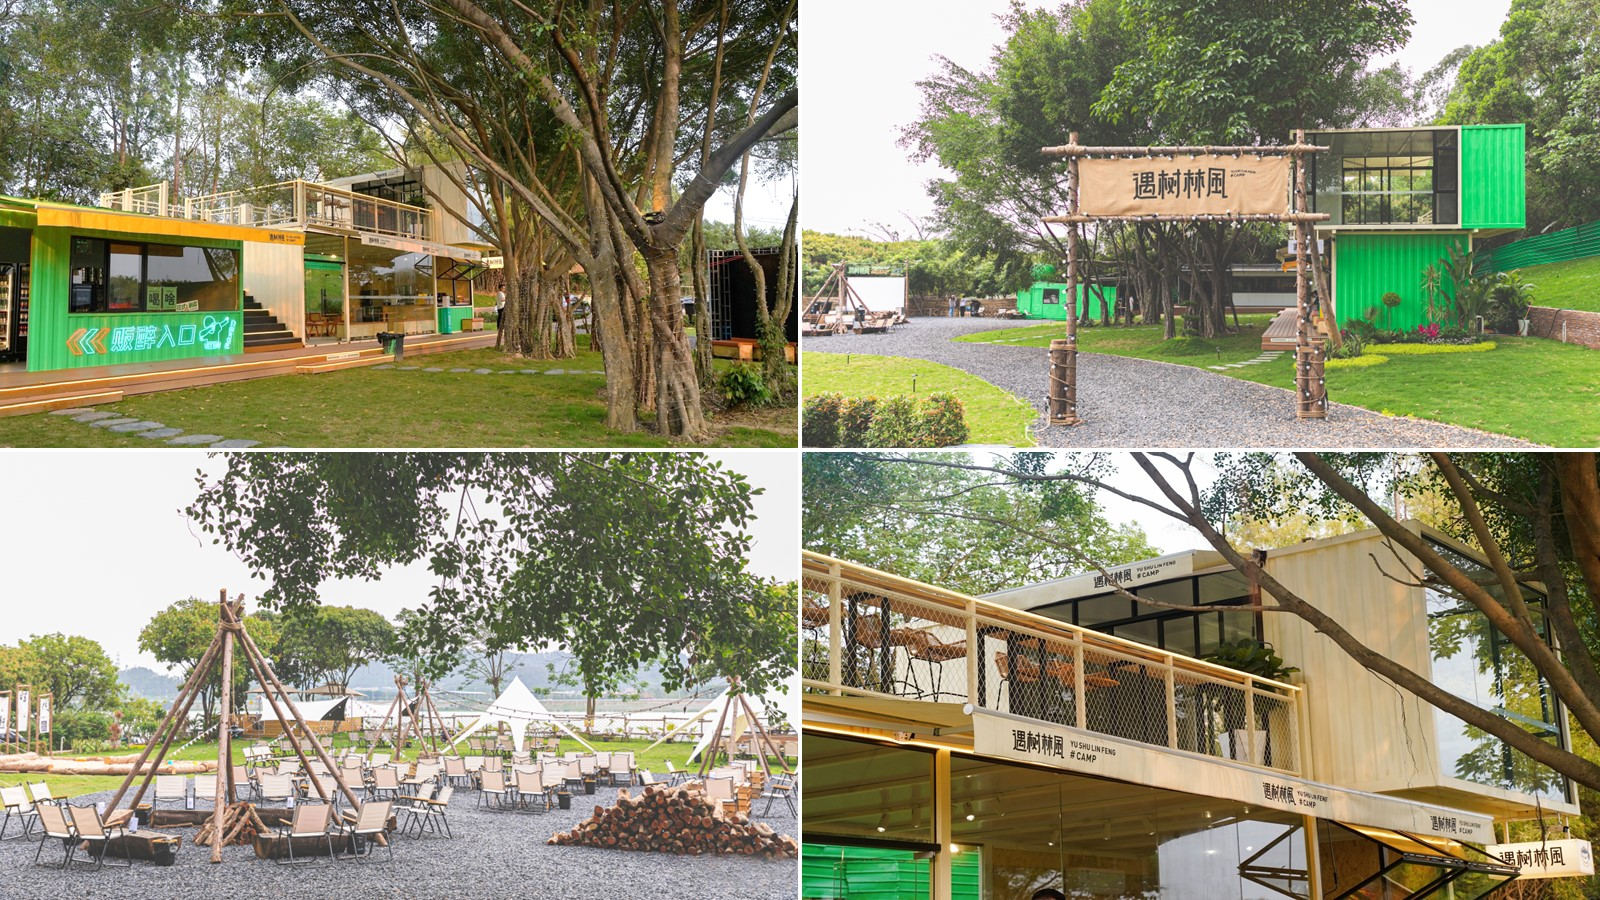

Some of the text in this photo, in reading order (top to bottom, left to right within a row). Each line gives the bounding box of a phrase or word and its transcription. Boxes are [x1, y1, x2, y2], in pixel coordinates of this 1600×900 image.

[110, 324, 197, 352] 贩醉入口
[1070, 740, 1116, 756] YU SHU LIN FENG
